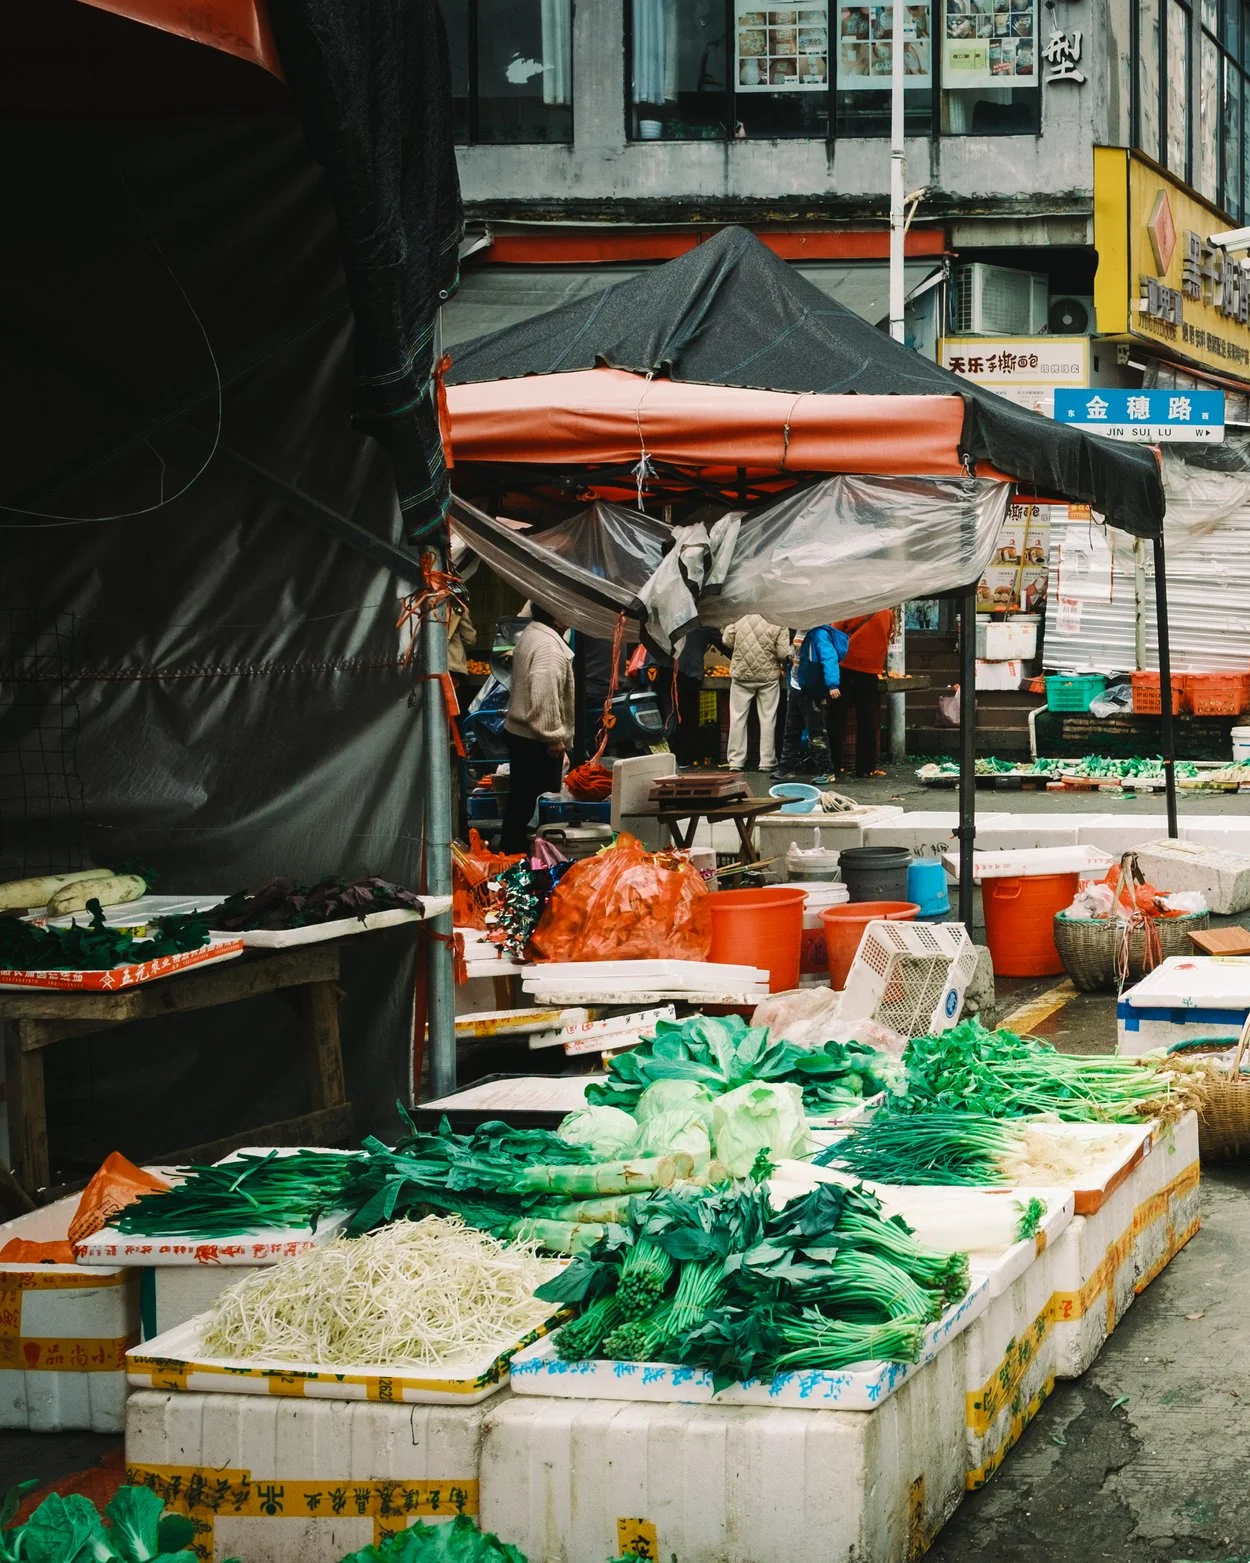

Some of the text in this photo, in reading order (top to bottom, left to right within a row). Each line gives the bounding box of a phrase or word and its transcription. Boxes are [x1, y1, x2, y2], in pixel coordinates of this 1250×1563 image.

[1042, 30, 1084, 83] 型
[949, 350, 1038, 374] 天乐手撕面包
[1085, 395, 1192, 421] 金穗路
[1107, 428, 1124, 436] JIN
[1132, 428, 1150, 436] SUI
[1158, 428, 1172, 436] LU
